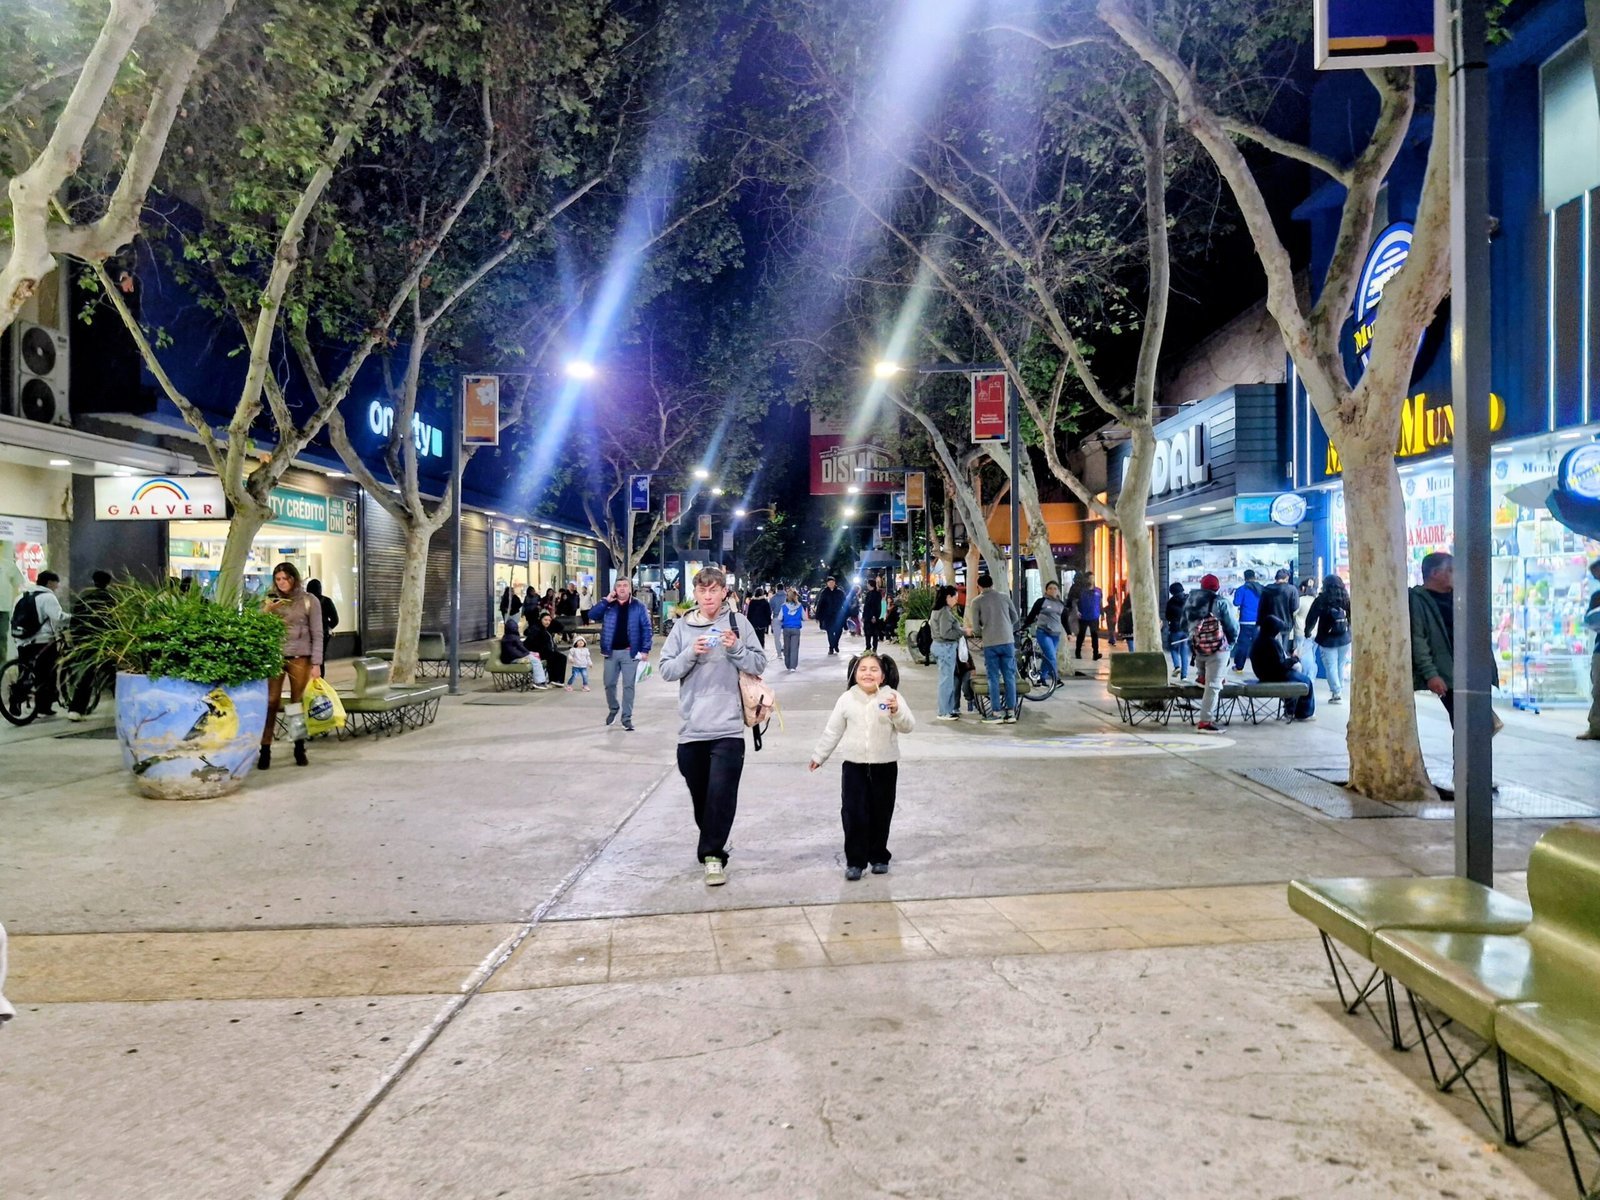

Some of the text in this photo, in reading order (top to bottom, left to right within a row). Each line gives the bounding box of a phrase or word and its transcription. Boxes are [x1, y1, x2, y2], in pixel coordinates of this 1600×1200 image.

[108, 504, 212, 515] GALVER
[286, 496, 325, 523] CRÉDITO
[330, 515, 343, 531] DNI
[1416, 524, 1446, 546] MADRE
